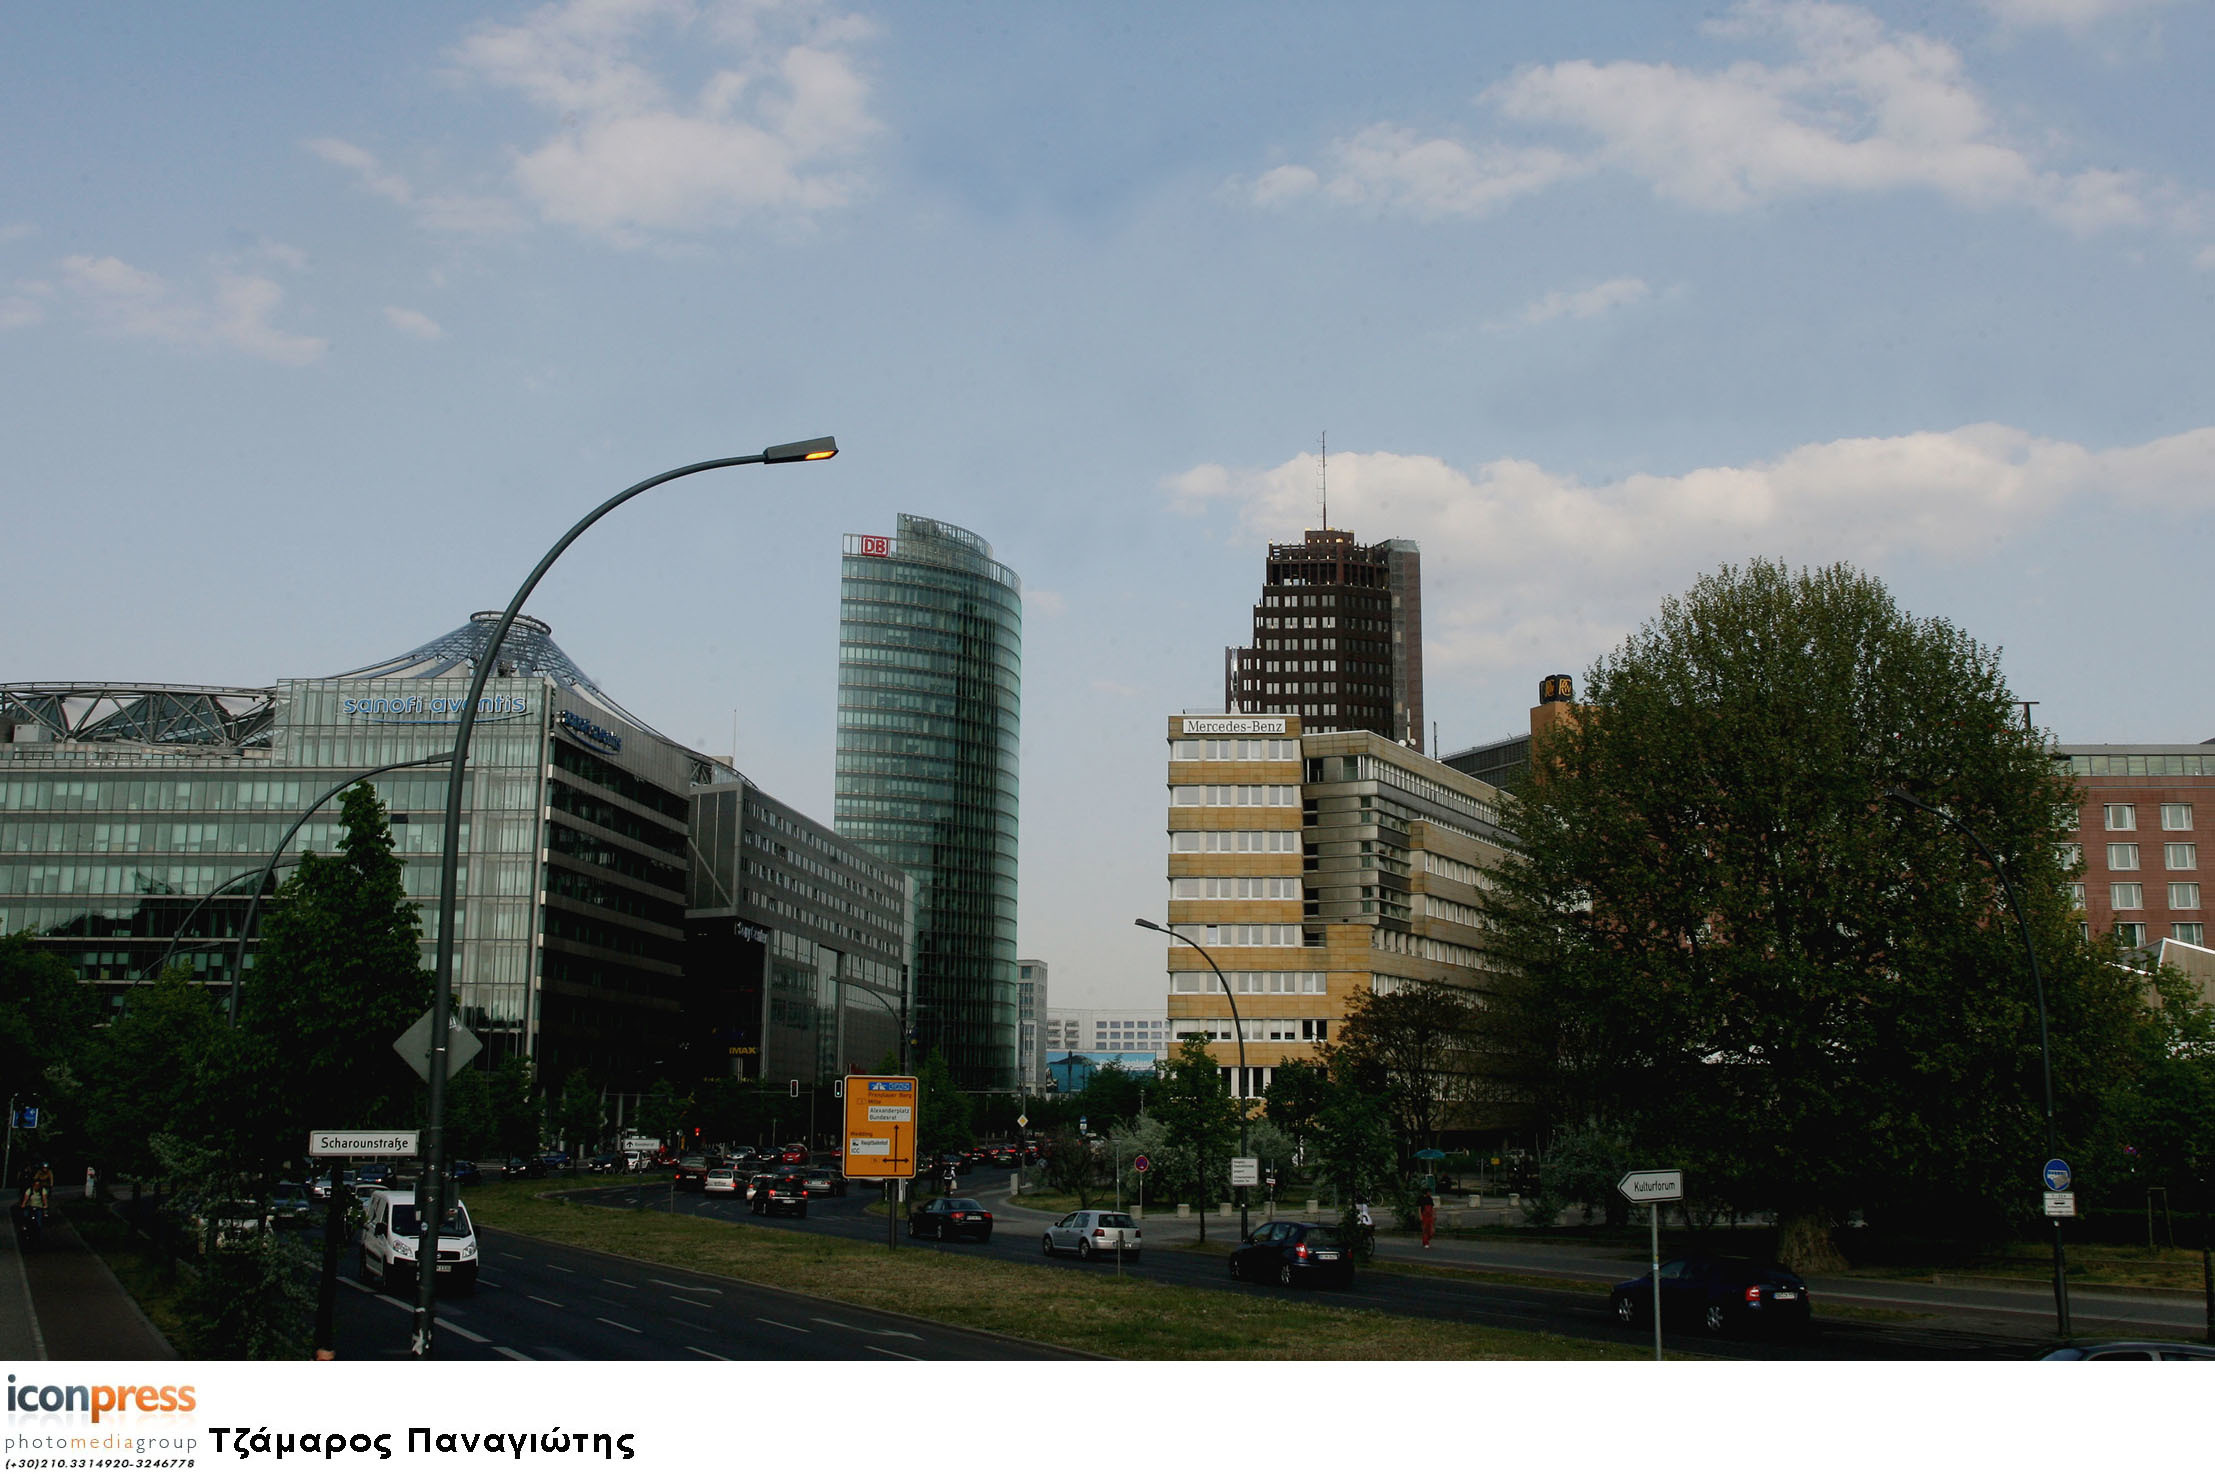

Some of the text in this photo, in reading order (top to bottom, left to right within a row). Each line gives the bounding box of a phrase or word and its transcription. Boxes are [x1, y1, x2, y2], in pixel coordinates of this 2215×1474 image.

[863, 537, 887, 554] DB
[343, 695, 526, 714] sanofi avntis
[1188, 720, 1283, 732] Mercedes-Benz
[729, 1047, 757, 1055] IMAX
[321, 1137, 408, 1151] Scharounstraße
[1633, 1181, 1676, 1192] Kulturforum
